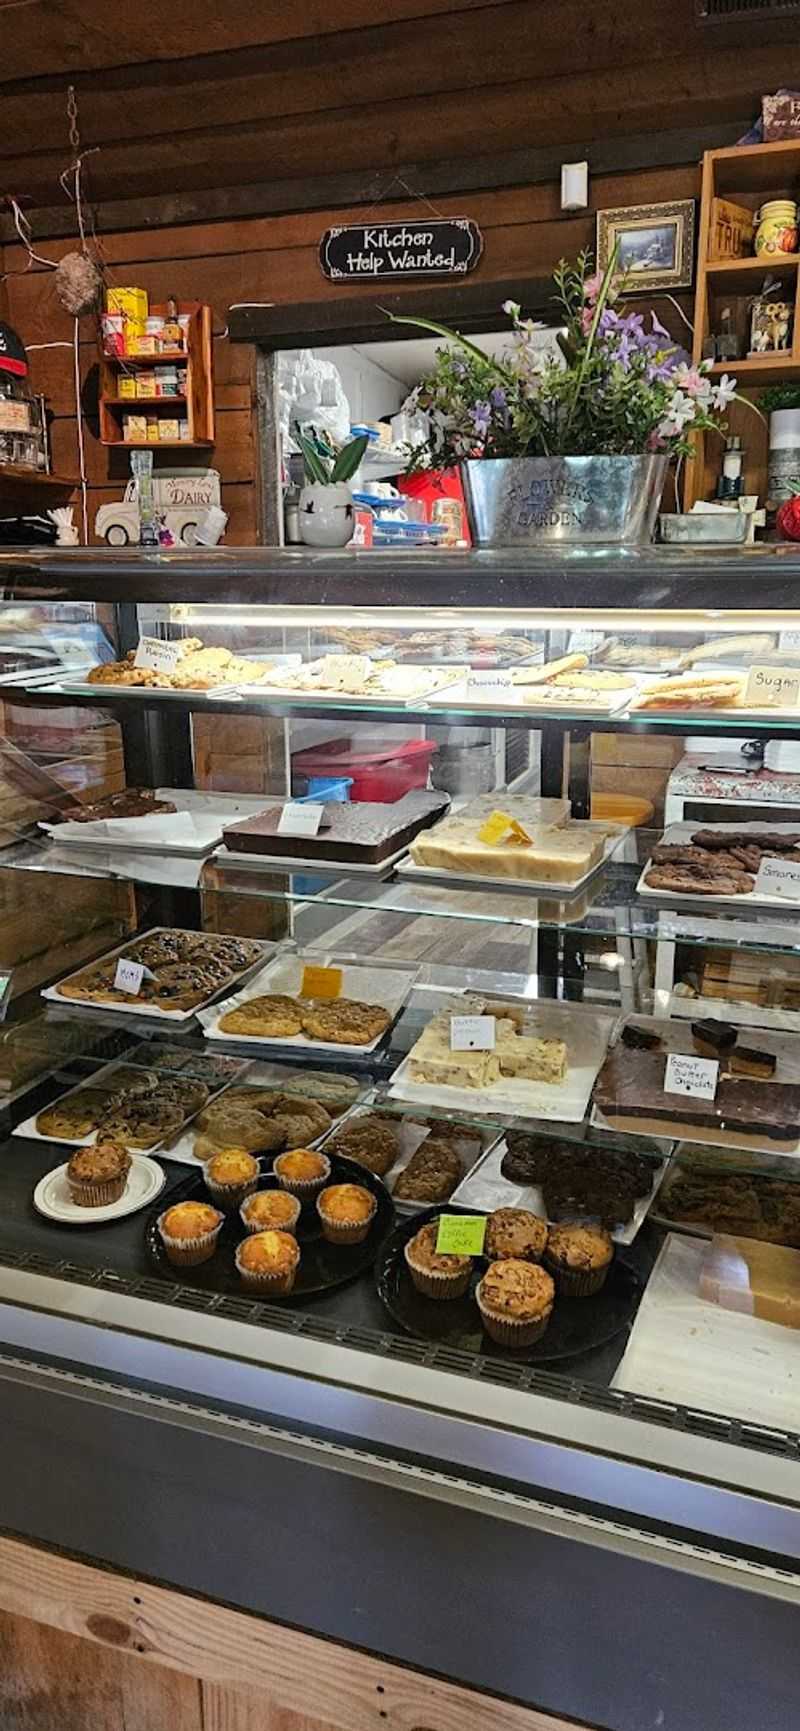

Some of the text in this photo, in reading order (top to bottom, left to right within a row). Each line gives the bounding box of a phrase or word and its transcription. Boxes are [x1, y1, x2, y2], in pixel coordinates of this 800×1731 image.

[364, 228, 433, 249] Kitchen
[347, 248, 455, 275] Help Wanted
[170, 489, 212, 505] DAIRY
[507, 479, 595, 504] FLOWERS
[517, 511, 583, 527] GARDEN
[755, 672, 799, 693] Sugar
